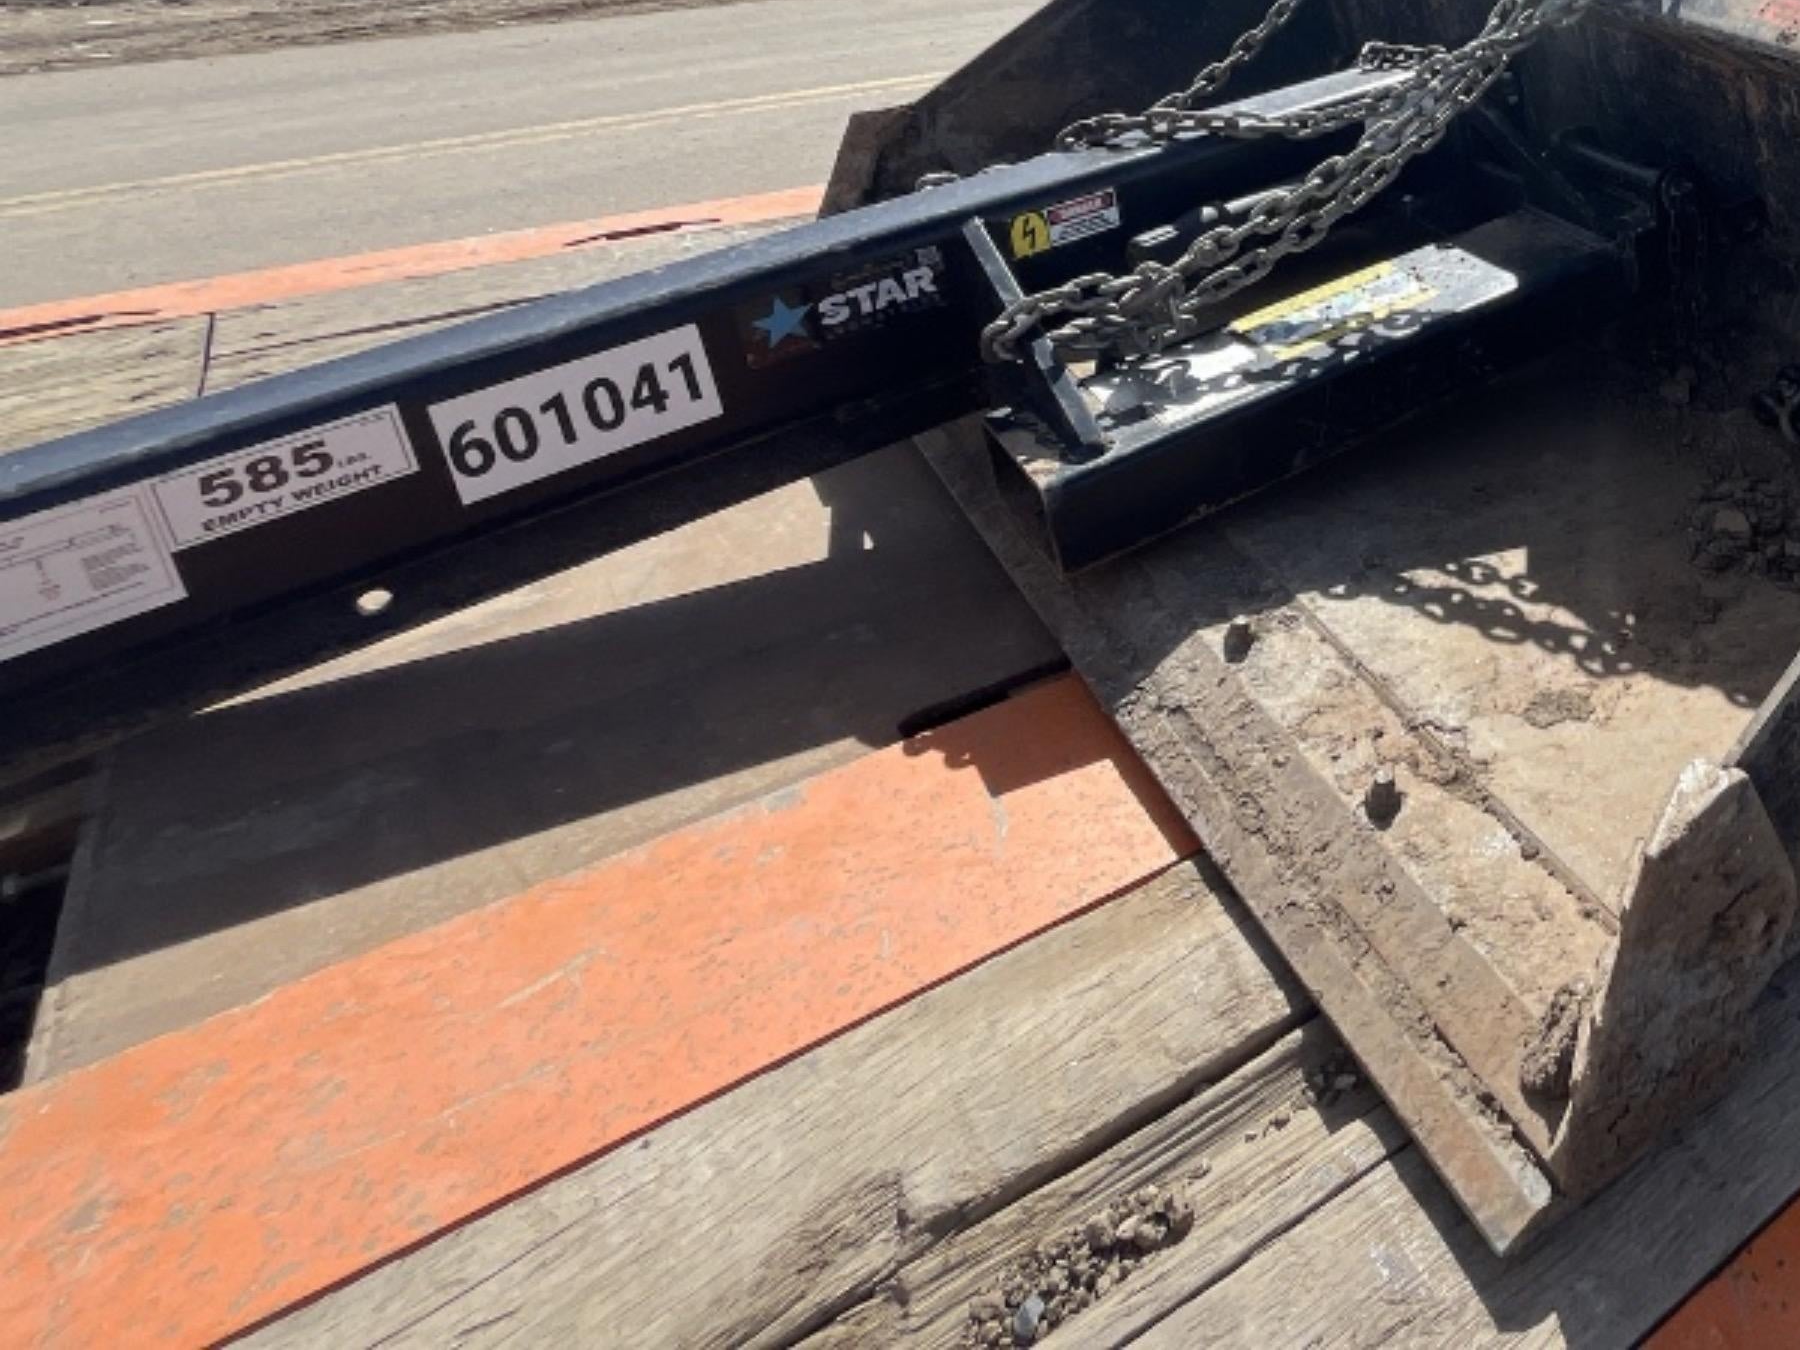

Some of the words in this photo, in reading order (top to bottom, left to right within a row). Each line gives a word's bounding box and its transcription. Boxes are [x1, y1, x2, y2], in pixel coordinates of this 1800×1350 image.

[818, 266, 937, 326] STAR
[449, 351, 703, 478] 601041
[198, 440, 333, 508] 585
[202, 496, 284, 532] EMPTY
[291, 464, 383, 502] WEIGHT
